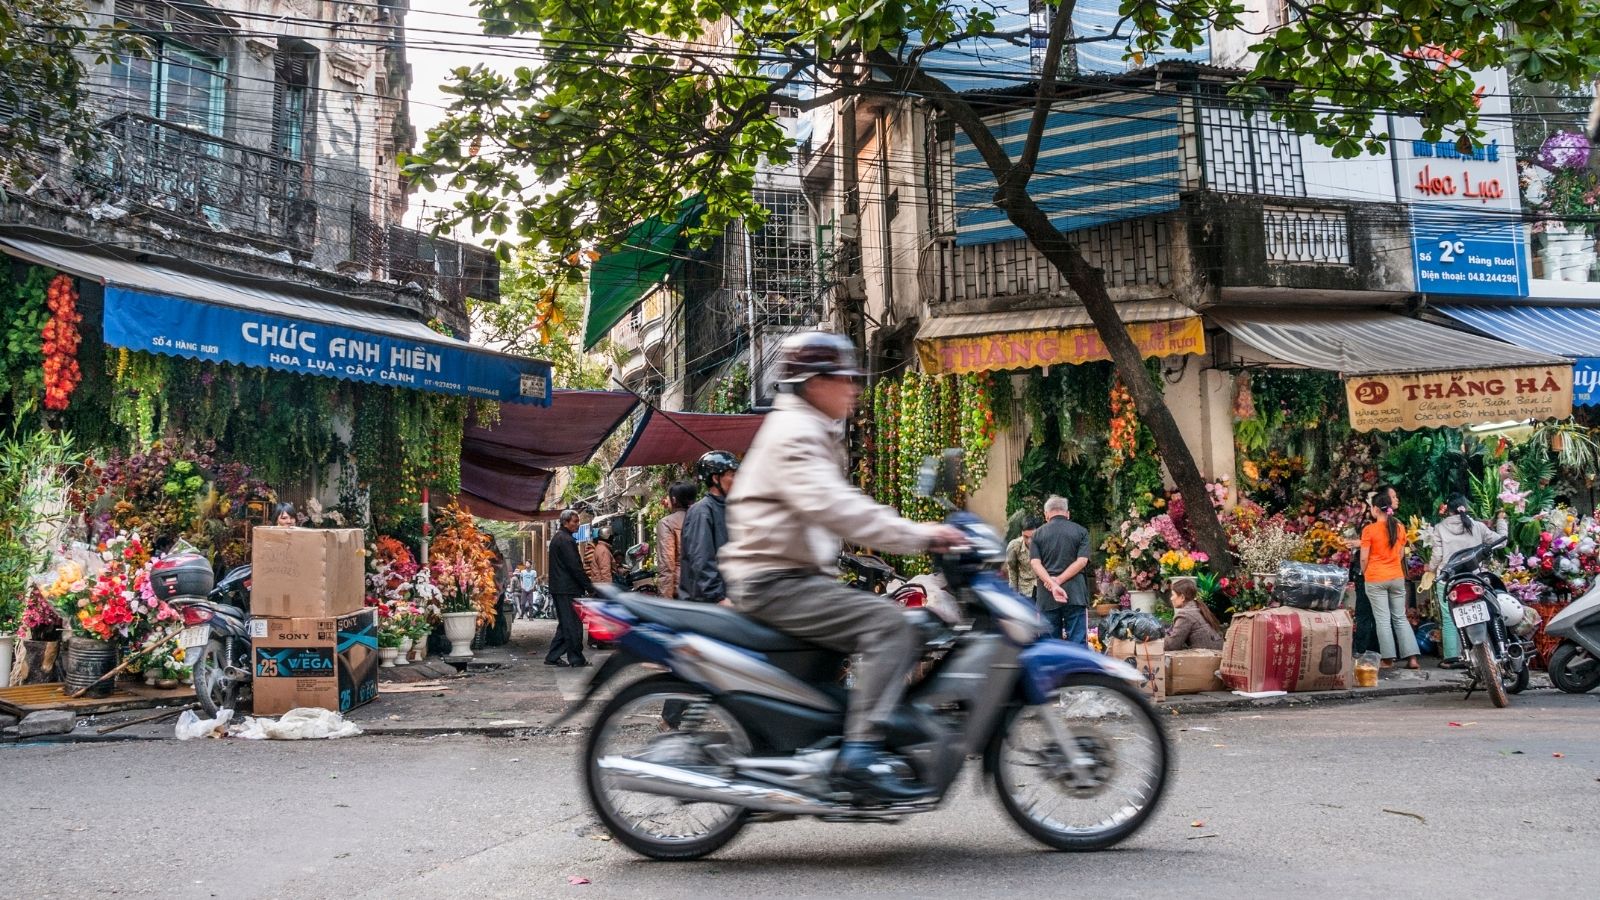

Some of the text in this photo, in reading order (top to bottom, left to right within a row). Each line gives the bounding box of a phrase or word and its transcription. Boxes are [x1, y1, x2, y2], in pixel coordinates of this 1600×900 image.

[1415, 164, 1457, 196] Hoa
[1419, 251, 1432, 261] Số
[1468, 255, 1492, 267] Hàng
[1421, 270, 1440, 281] Điện
[1441, 271, 1466, 282] thoại:
[152, 335, 166, 346] SỐ
[165, 339, 172, 347] 4
[175, 339, 197, 351] HÀNG
[241, 321, 440, 373] CHÚC ANH HIỀN
[269, 352, 301, 366] HOA
[307, 358, 336, 372] LỤA
[345, 363, 375, 377] CÂY
[380, 368, 414, 383] CẢNH
[1402, 369, 1561, 402] THẮNG HÀ
[1478, 409, 1495, 417] Hoa
[338, 617, 358, 632] SONY
[278, 632, 311, 641] SONY
[261, 658, 278, 677] 25
[288, 658, 333, 669] WEGA
